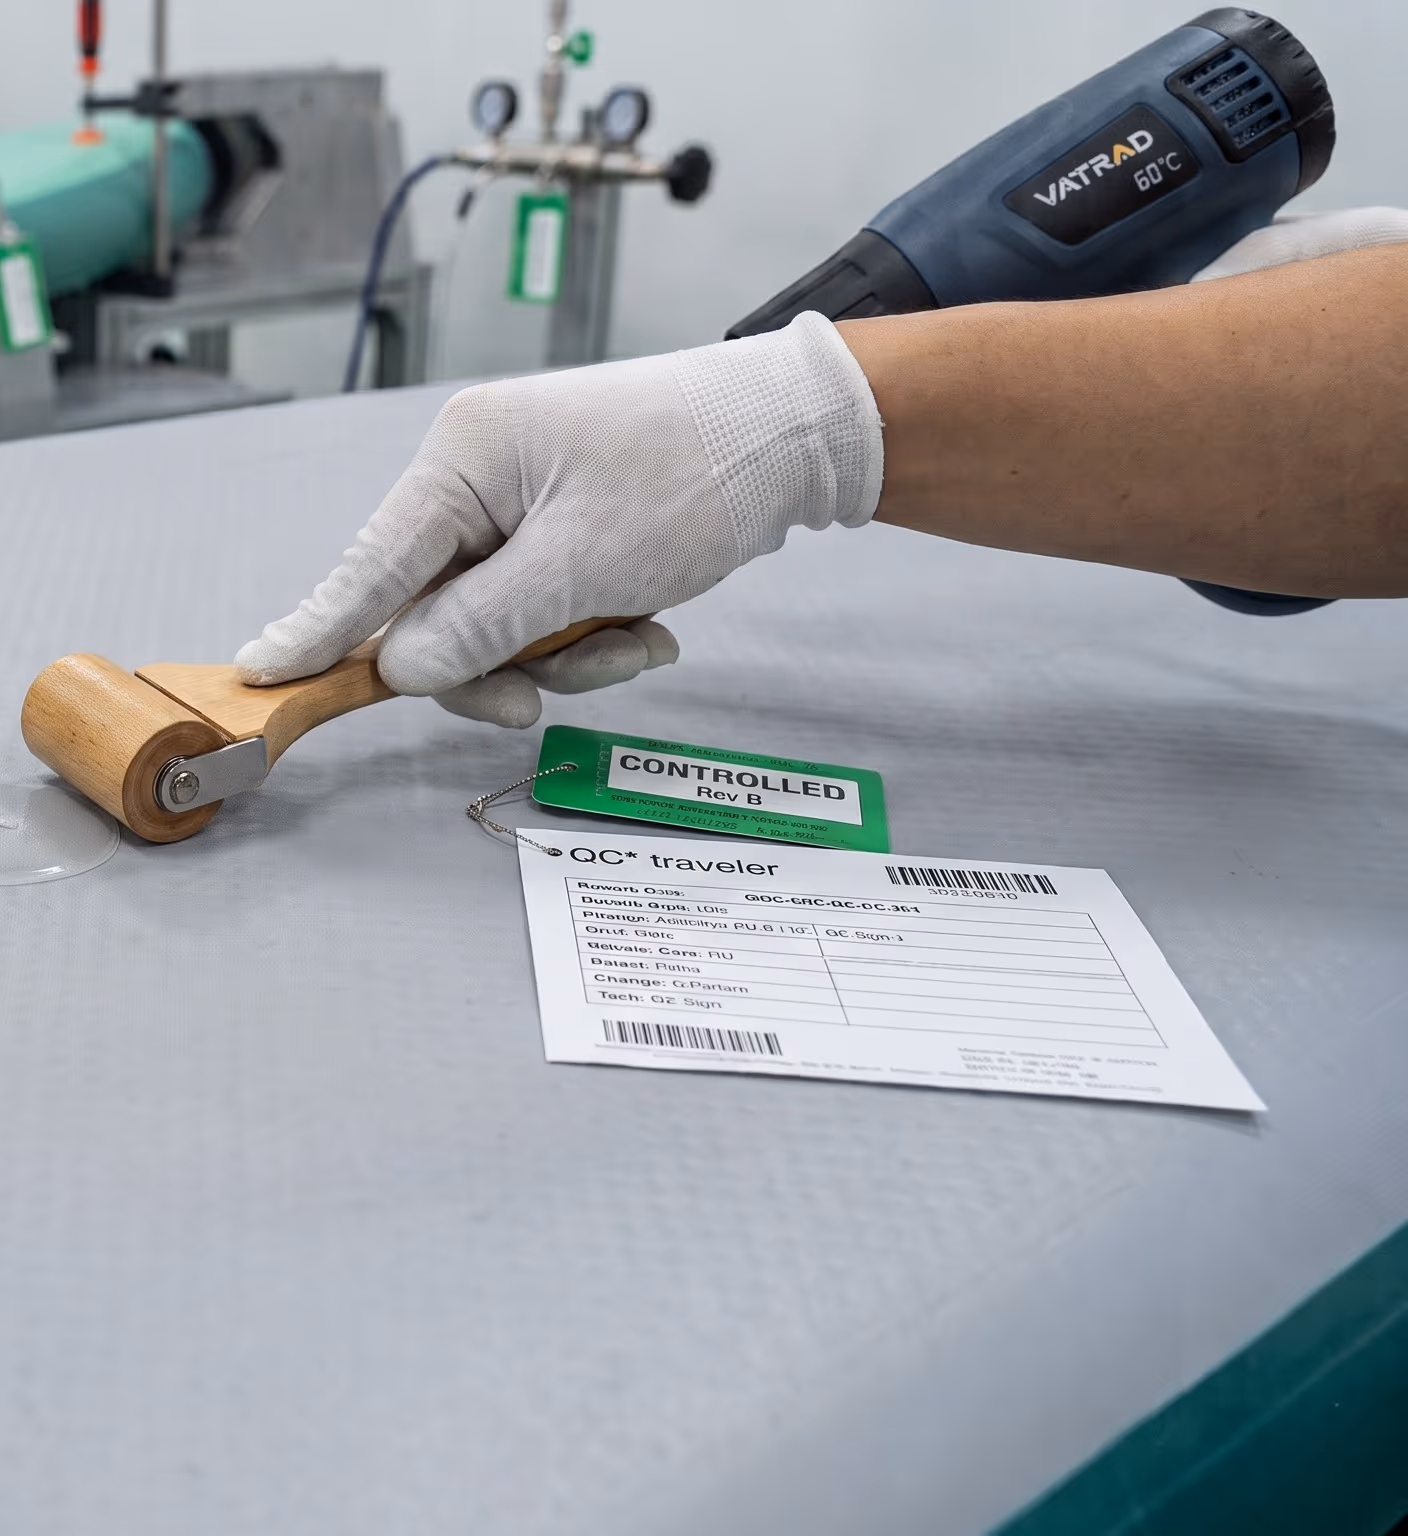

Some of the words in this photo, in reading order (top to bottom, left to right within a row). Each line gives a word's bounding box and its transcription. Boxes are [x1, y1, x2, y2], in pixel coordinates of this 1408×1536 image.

[1033, 129, 1154, 206] VATRAD
[1133, 152, 1182, 192] 60°C
[619, 753, 846, 801] CONTROLLED
[697, 785, 739, 802] Rev
[747, 793, 763, 806] B
[649, 853, 780, 876] traveler
